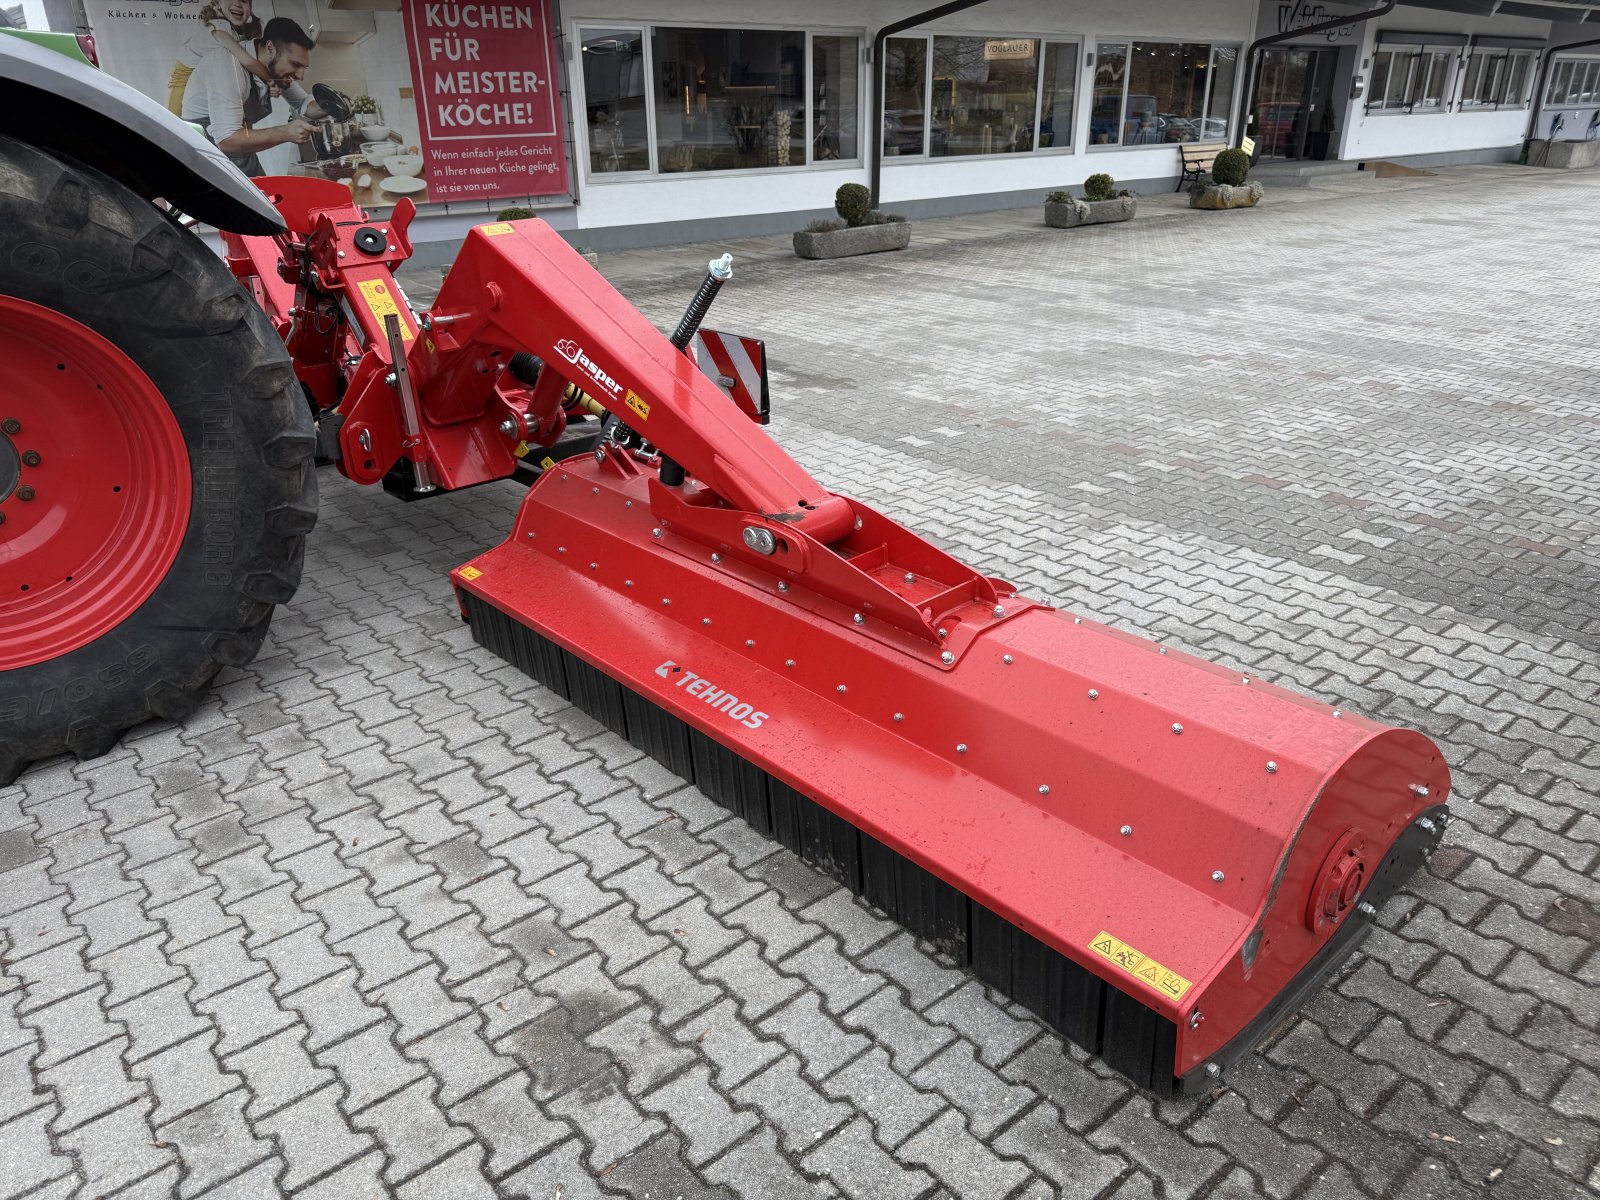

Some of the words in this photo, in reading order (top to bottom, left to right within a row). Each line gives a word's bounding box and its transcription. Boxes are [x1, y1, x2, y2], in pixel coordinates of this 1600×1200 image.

[108, 10, 147, 18] Küchen
[164, 11, 204, 20] Wohnen
[425, 0, 533, 29] KÜCHEN
[429, 32, 480, 61] FÜR
[434, 71, 546, 94] MEISTER-
[438, 98, 534, 127] KÖCHE!
[431, 149, 459, 160] Wenn
[461, 147, 494, 159] einfach
[495, 146, 518, 161] jedes
[520, 145, 553, 156] Gericht
[433, 166, 443, 176] in
[445, 165, 467, 176] Ihrer
[469, 166, 497, 175] neuen
[499, 162, 526, 173] Küche
[528, 161, 560, 175] gelingt,
[435, 183, 447, 193] ist
[449, 182, 462, 192] sie
[463, 183, 480, 191] von
[482, 182, 501, 190] uns.
[553, 346, 624, 394] Jasper
[200, 385, 236, 588] TRELLEBORG
[675, 671, 770, 729] TEHNOS
